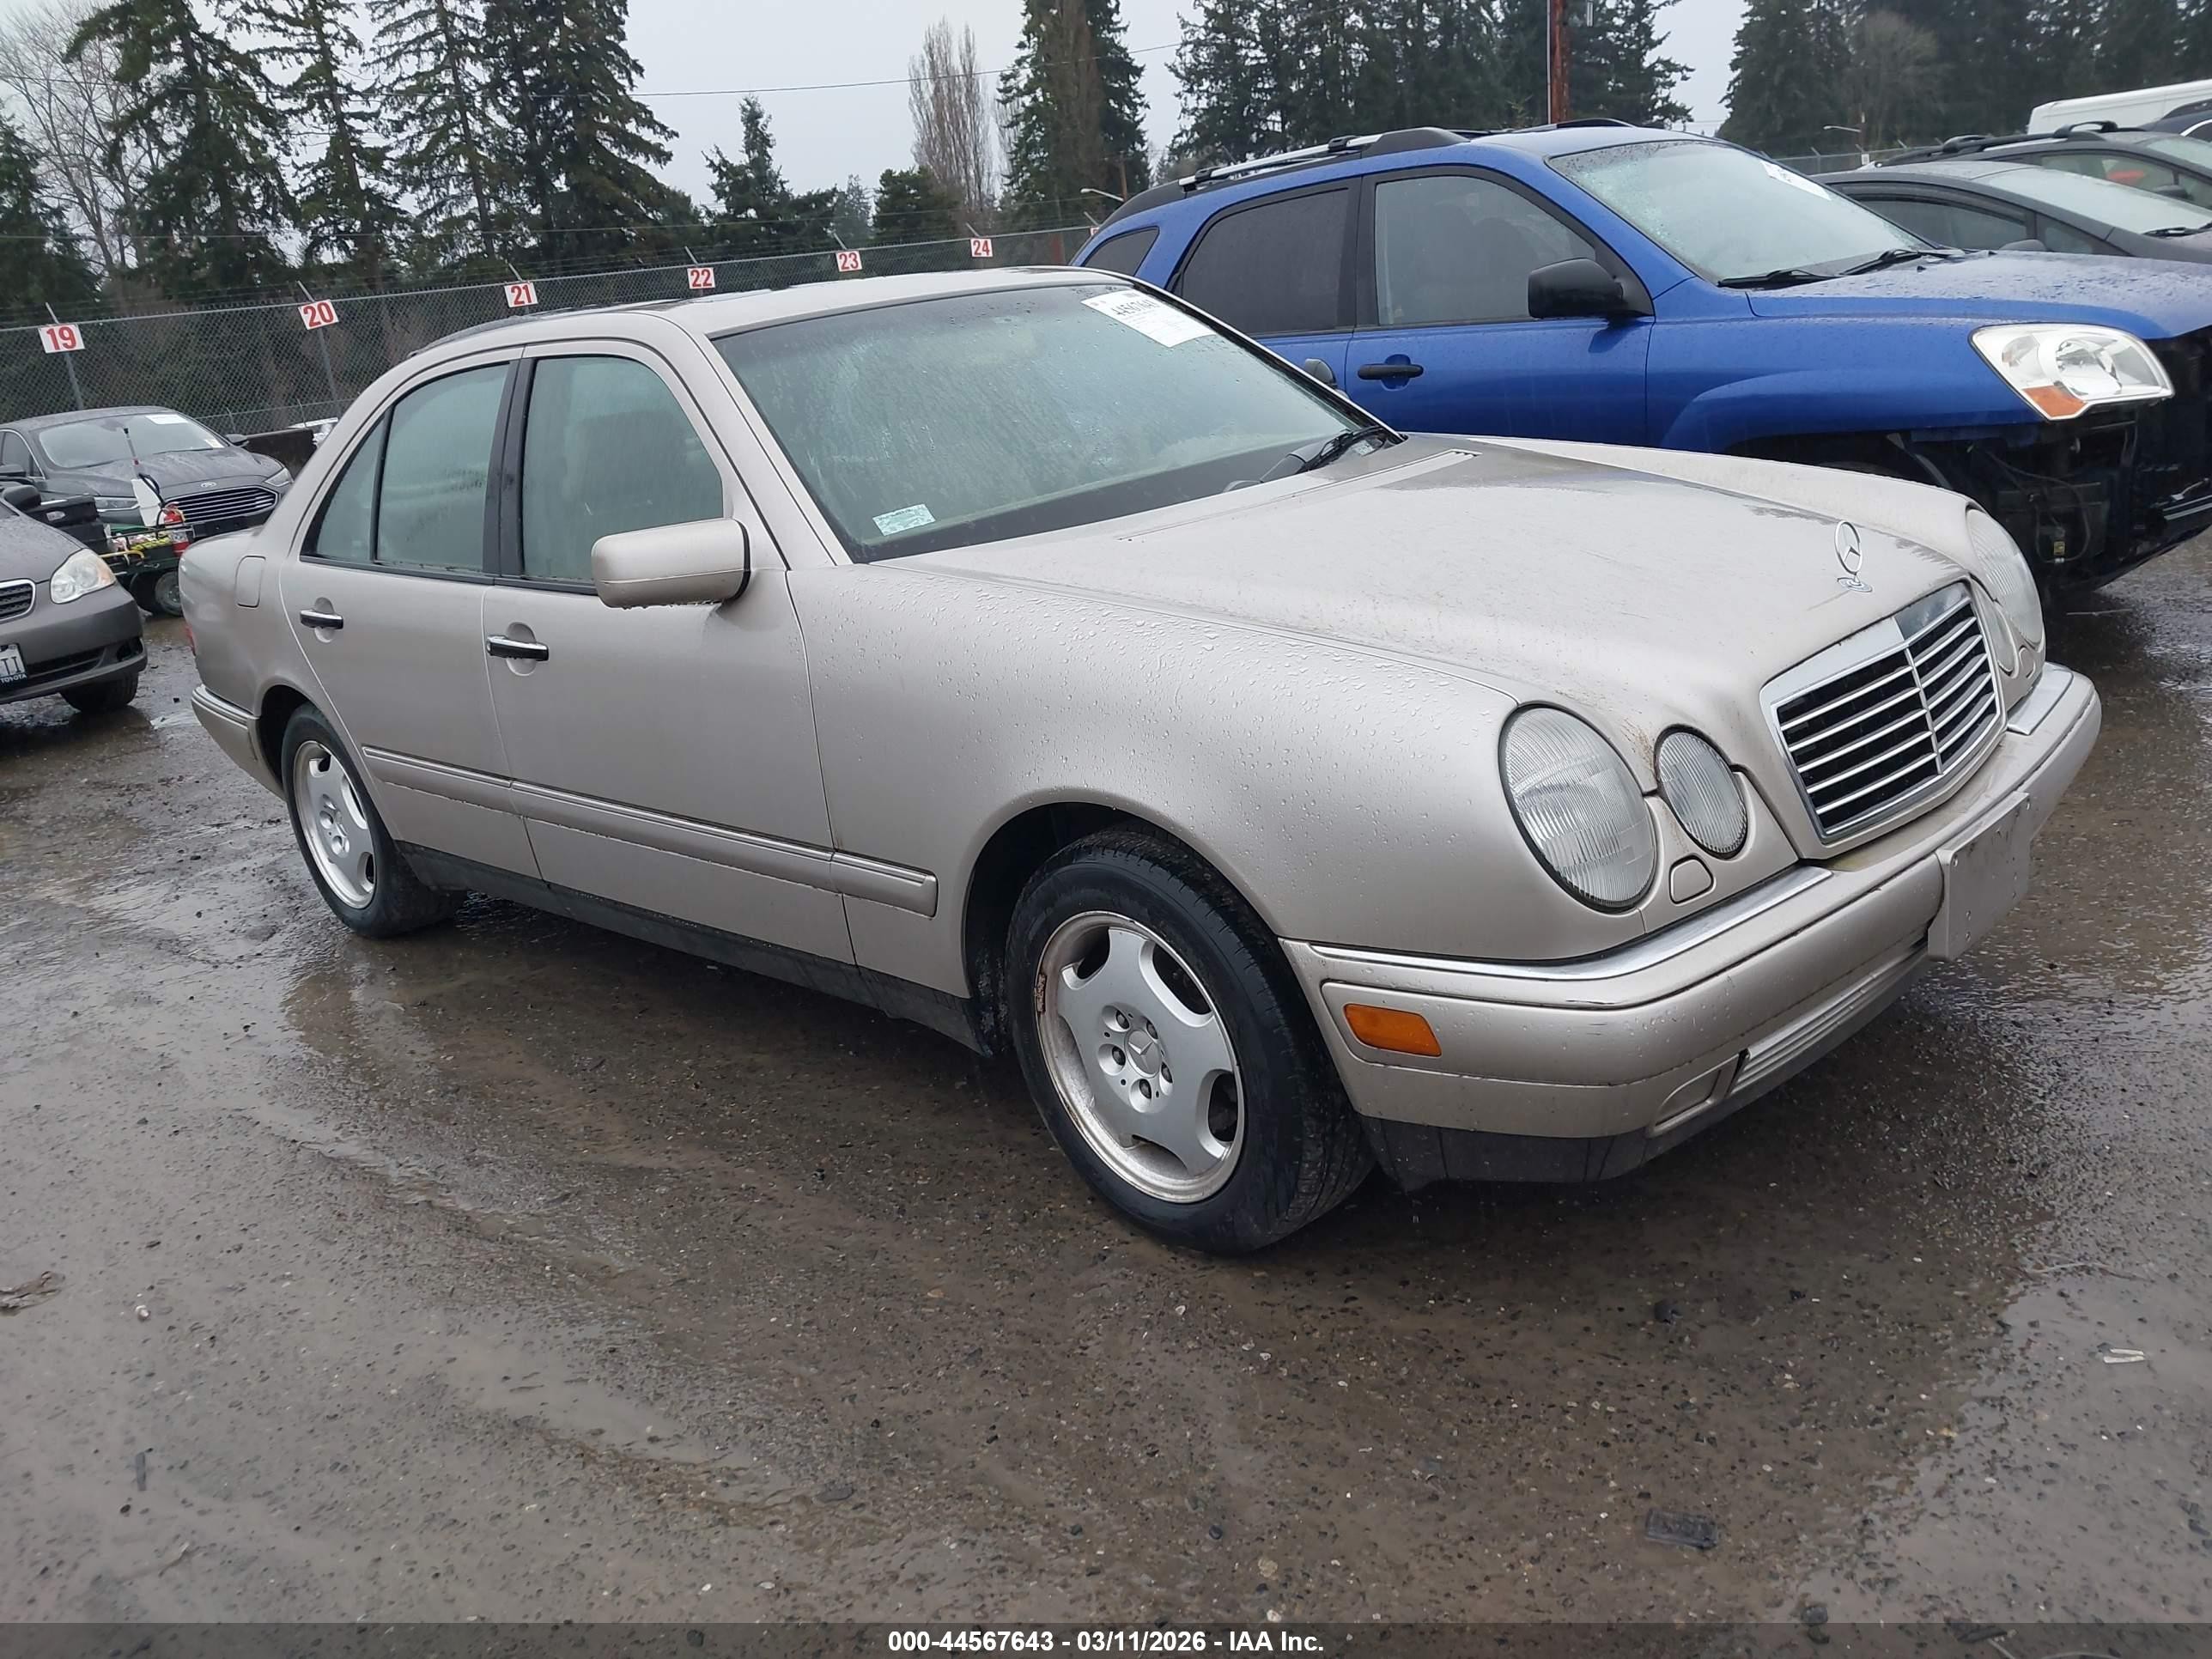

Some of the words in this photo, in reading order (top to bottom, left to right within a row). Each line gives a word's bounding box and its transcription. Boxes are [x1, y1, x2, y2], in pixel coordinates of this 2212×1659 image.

[973, 240, 990, 255] 24
[839, 252, 859, 270] 23
[690, 269, 713, 288] 22
[510, 284, 532, 306] 21
[303, 301, 334, 328] 20
[46, 326, 76, 350] 19
[0, 673, 27, 684] TOYOTA
